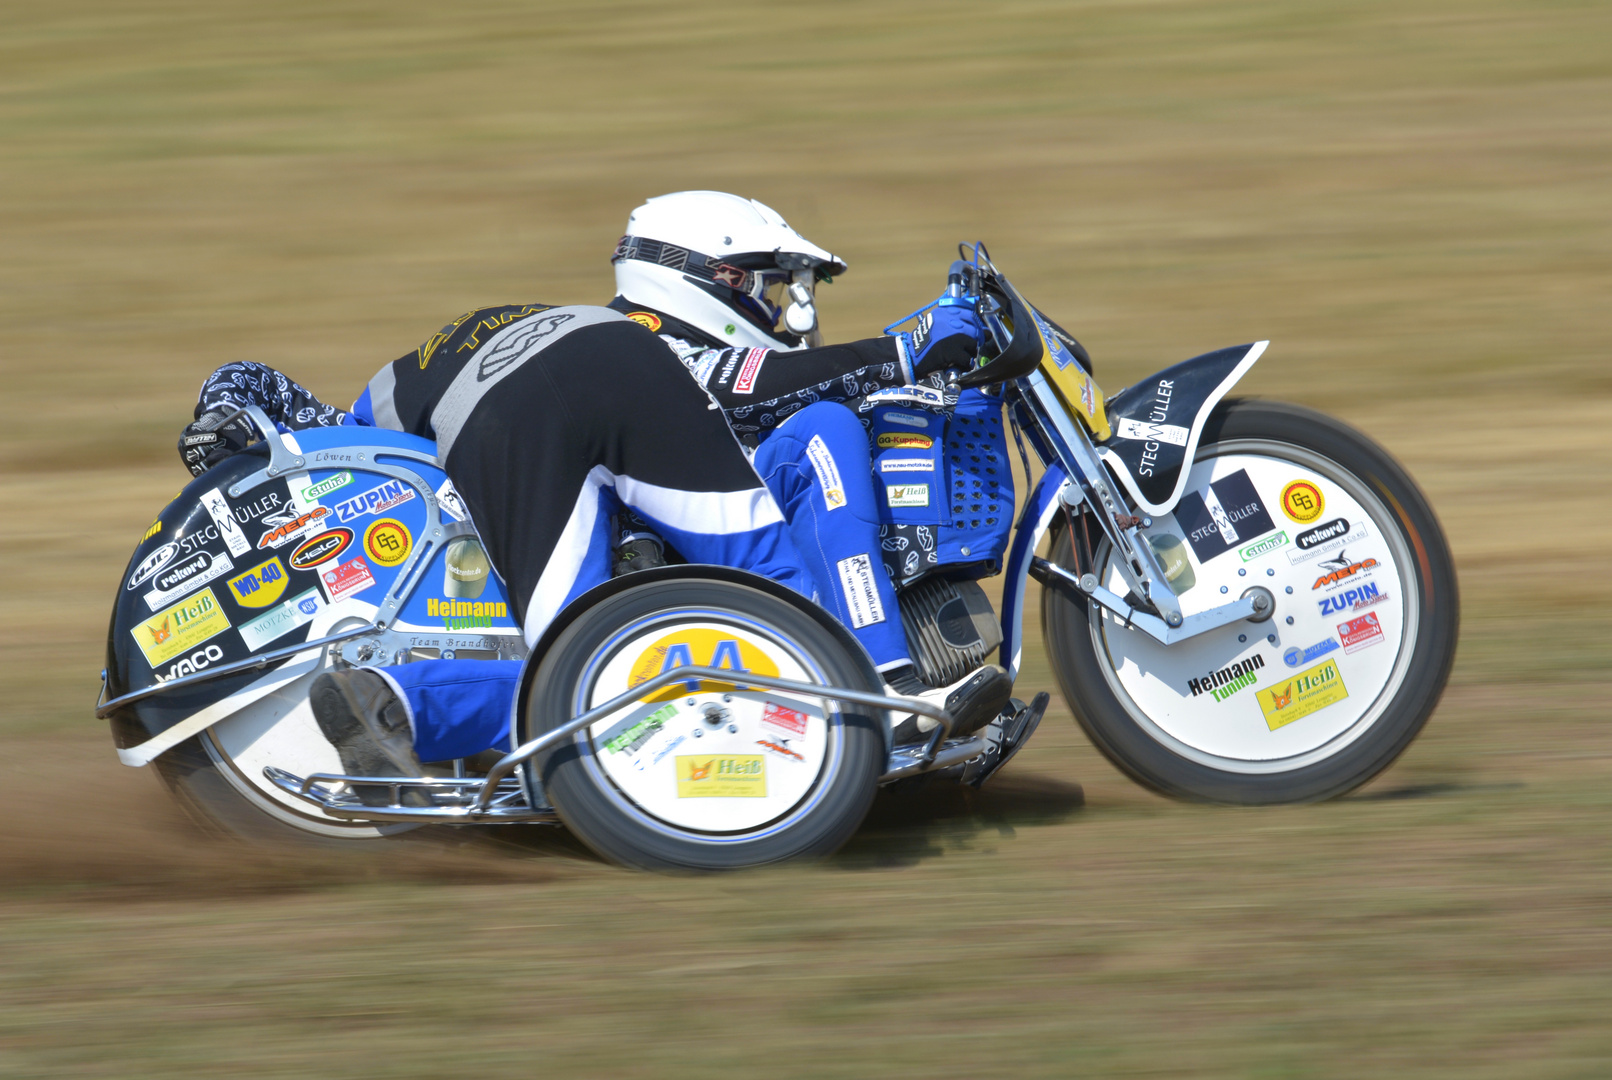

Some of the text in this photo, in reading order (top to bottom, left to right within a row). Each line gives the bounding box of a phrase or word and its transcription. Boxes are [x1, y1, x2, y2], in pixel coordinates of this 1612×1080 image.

[871, 387, 938, 401] MEFO
[878, 435, 931, 447] GG-Kupplung
[1139, 380, 1174, 477] STEGMÜLLER
[315, 452, 352, 462] Löwen
[310, 475, 345, 497] stuha
[337, 481, 405, 520] ZUPIN
[180, 492, 283, 554] STEGMÜLLER
[260, 507, 326, 547] MEFO
[1191, 502, 1260, 543] STEGMÜLLER
[1301, 520, 1346, 547] rekord
[294, 537, 340, 566] Held
[1248, 536, 1281, 558] stuha
[134, 548, 171, 584] HJC
[161, 556, 208, 589] rekord
[233, 562, 282, 598] WD-40
[1312, 558, 1377, 590] MEFO
[152, 588, 183, 607] Holzmann
[183, 573, 204, 590] GmbH
[1318, 581, 1379, 616] ZUPIN
[173, 595, 214, 627] Heiß
[254, 608, 296, 634] MOTZKE
[301, 600, 316, 613] NSU
[427, 598, 507, 618] Heimann
[177, 611, 218, 635] Forstmaschinen
[442, 614, 492, 631] Tuning
[410, 637, 440, 646] Team
[1187, 653, 1265, 697] Heimann
[1210, 669, 1258, 703] Tuning
[1296, 665, 1336, 695] Heiß
[1298, 680, 1338, 702] Forstmaschinen
[718, 758, 762, 775] Heiß
